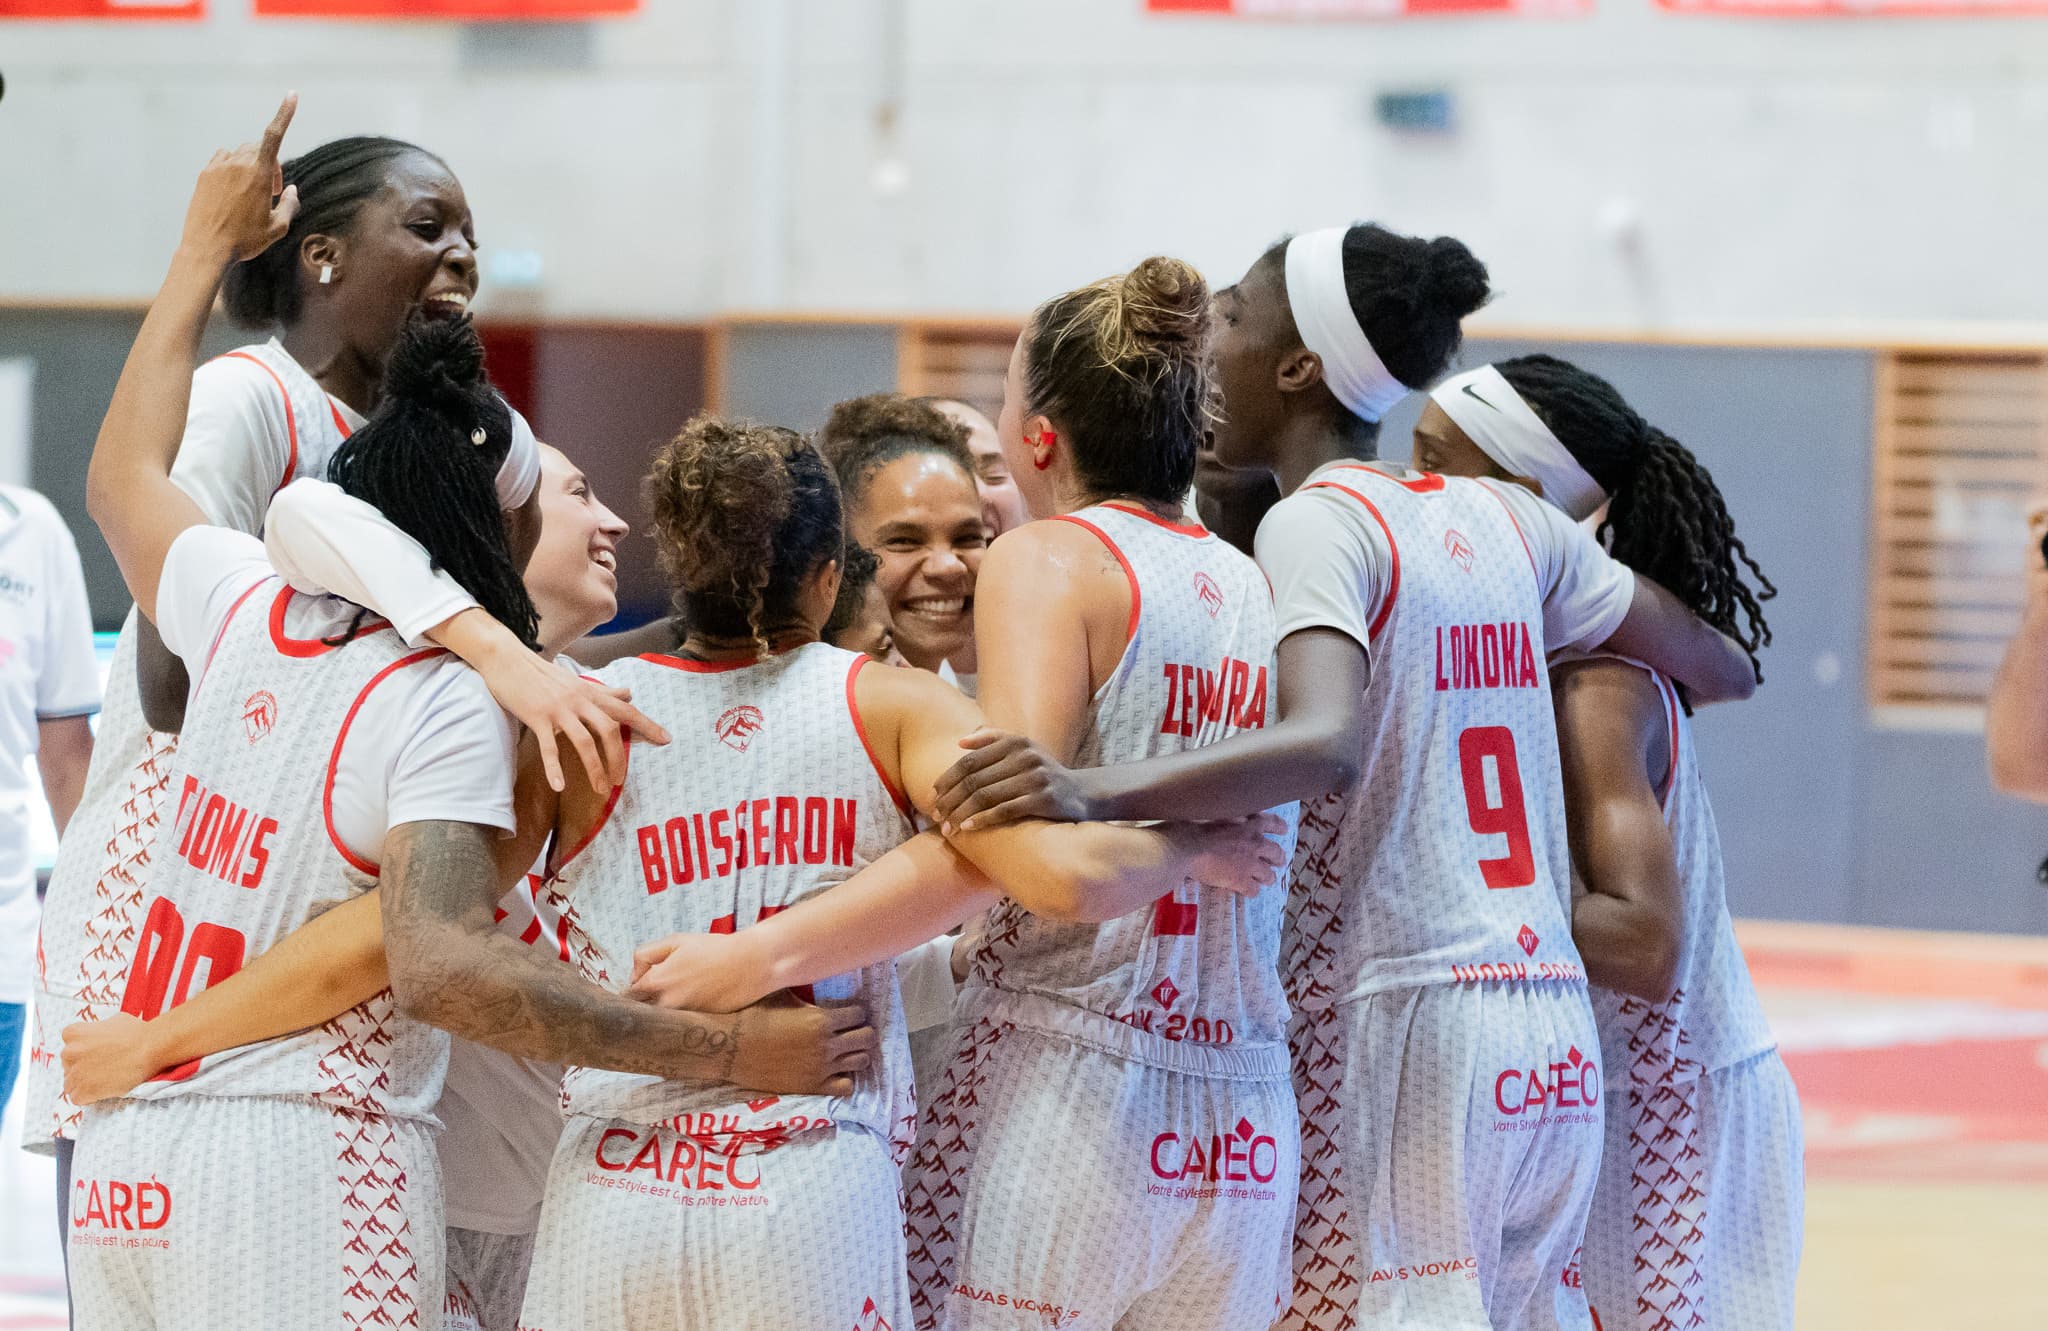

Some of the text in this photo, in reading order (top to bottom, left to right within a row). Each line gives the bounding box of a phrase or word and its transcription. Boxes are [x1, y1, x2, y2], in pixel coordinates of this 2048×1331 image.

[1435, 621, 1539, 692] LOKOKA
[1458, 725, 1536, 890] 9
[636, 796, 858, 896] BOISSERON
[586, 1171, 614, 1188] Votre
[617, 1178, 646, 1194] Style
[649, 1185, 671, 1198] est
[672, 1190, 694, 1207] dns
[1146, 1183, 1172, 1198] Votre
